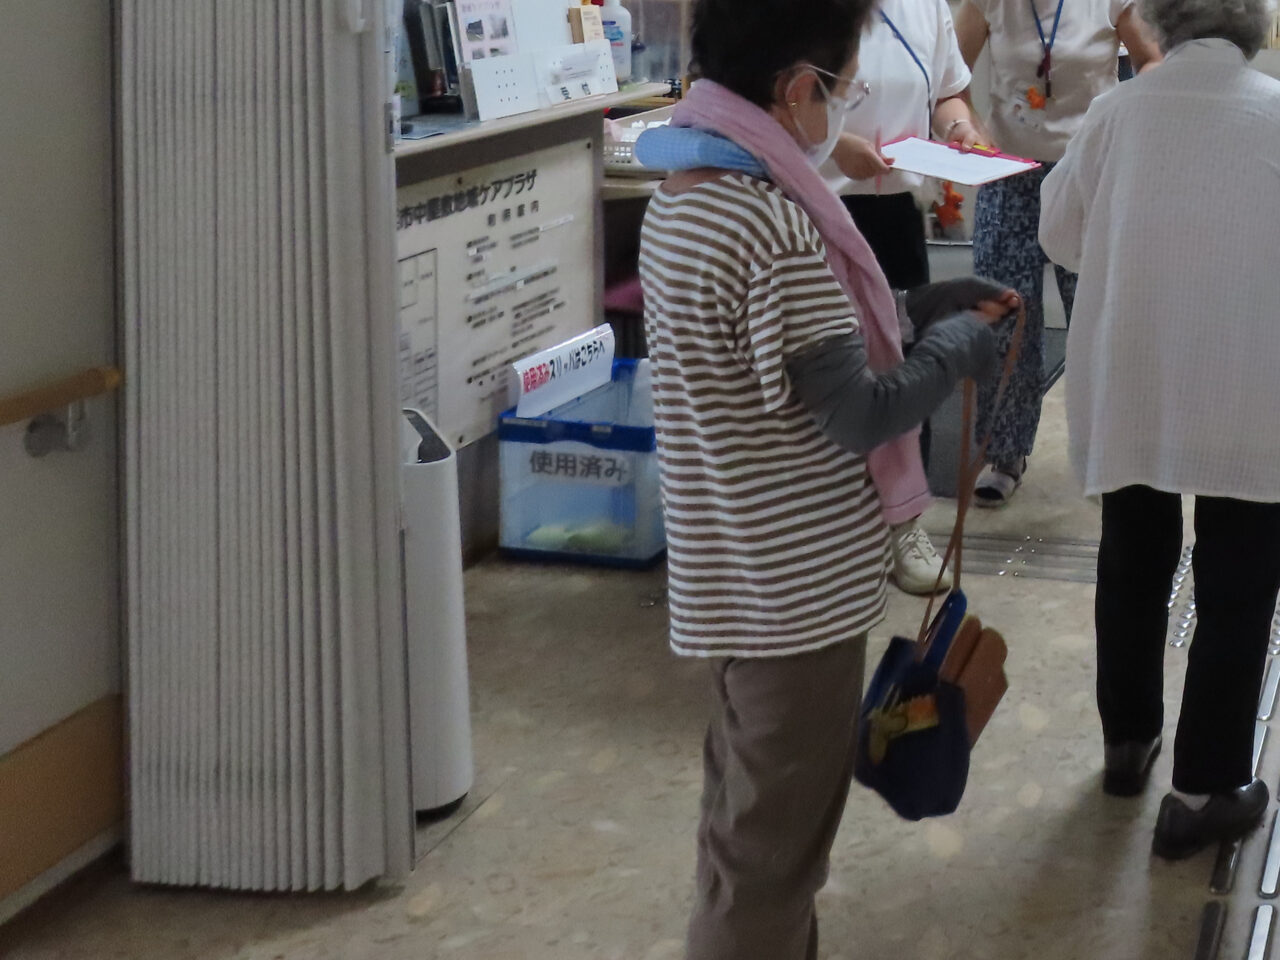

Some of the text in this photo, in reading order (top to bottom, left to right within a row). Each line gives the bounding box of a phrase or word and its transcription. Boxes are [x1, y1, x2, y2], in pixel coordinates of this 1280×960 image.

[396, 168, 538, 231] 市中屋敷地域ケアプラザ
[529, 450, 628, 482] 使用済み
